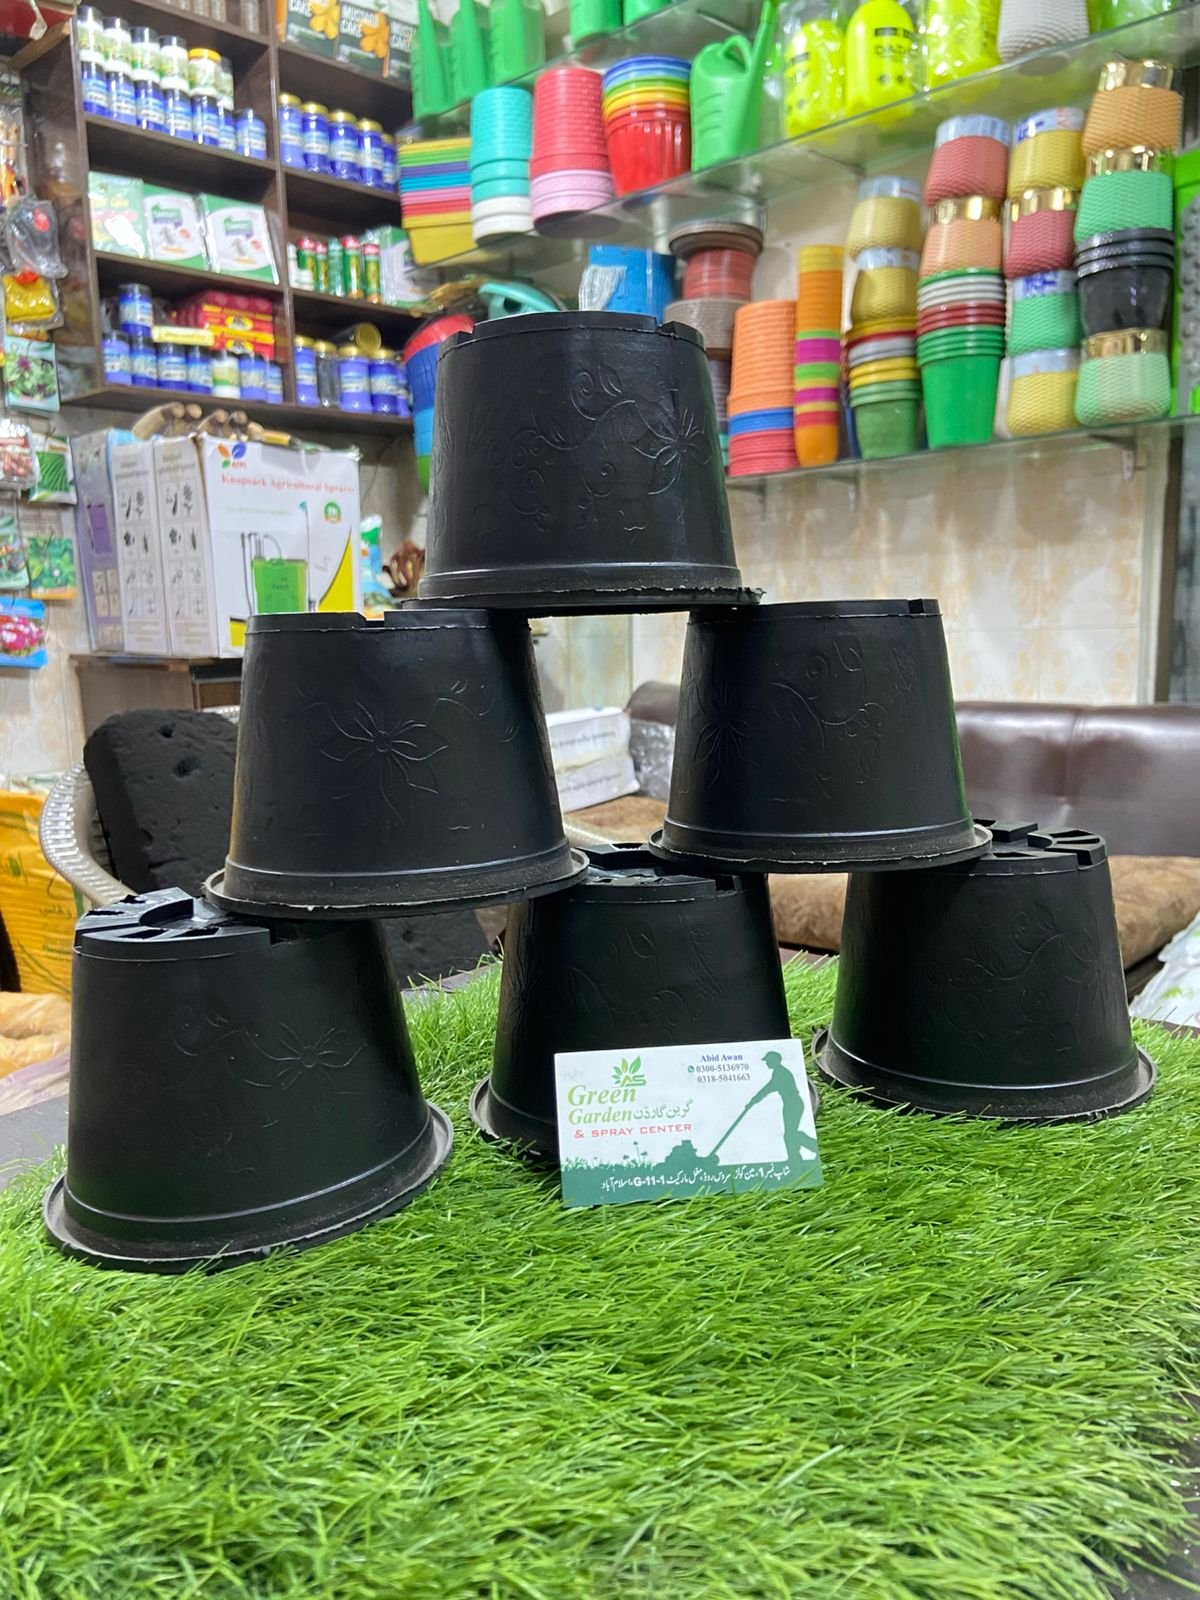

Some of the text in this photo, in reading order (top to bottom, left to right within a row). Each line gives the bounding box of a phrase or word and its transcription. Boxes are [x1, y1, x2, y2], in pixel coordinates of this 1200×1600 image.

[221, 473, 268, 486] Knapsack
[270, 479, 322, 491] Agricultural
[700, 1054, 743, 1062] Abid Awan
[696, 1063, 749, 1073] 0300-5136970
[567, 1084, 637, 1106] Green
[568, 1106, 632, 1126] Garden
[665, 1099, 694, 1119] گرین
[574, 1123, 692, 1139] & SPRAY CENTER
